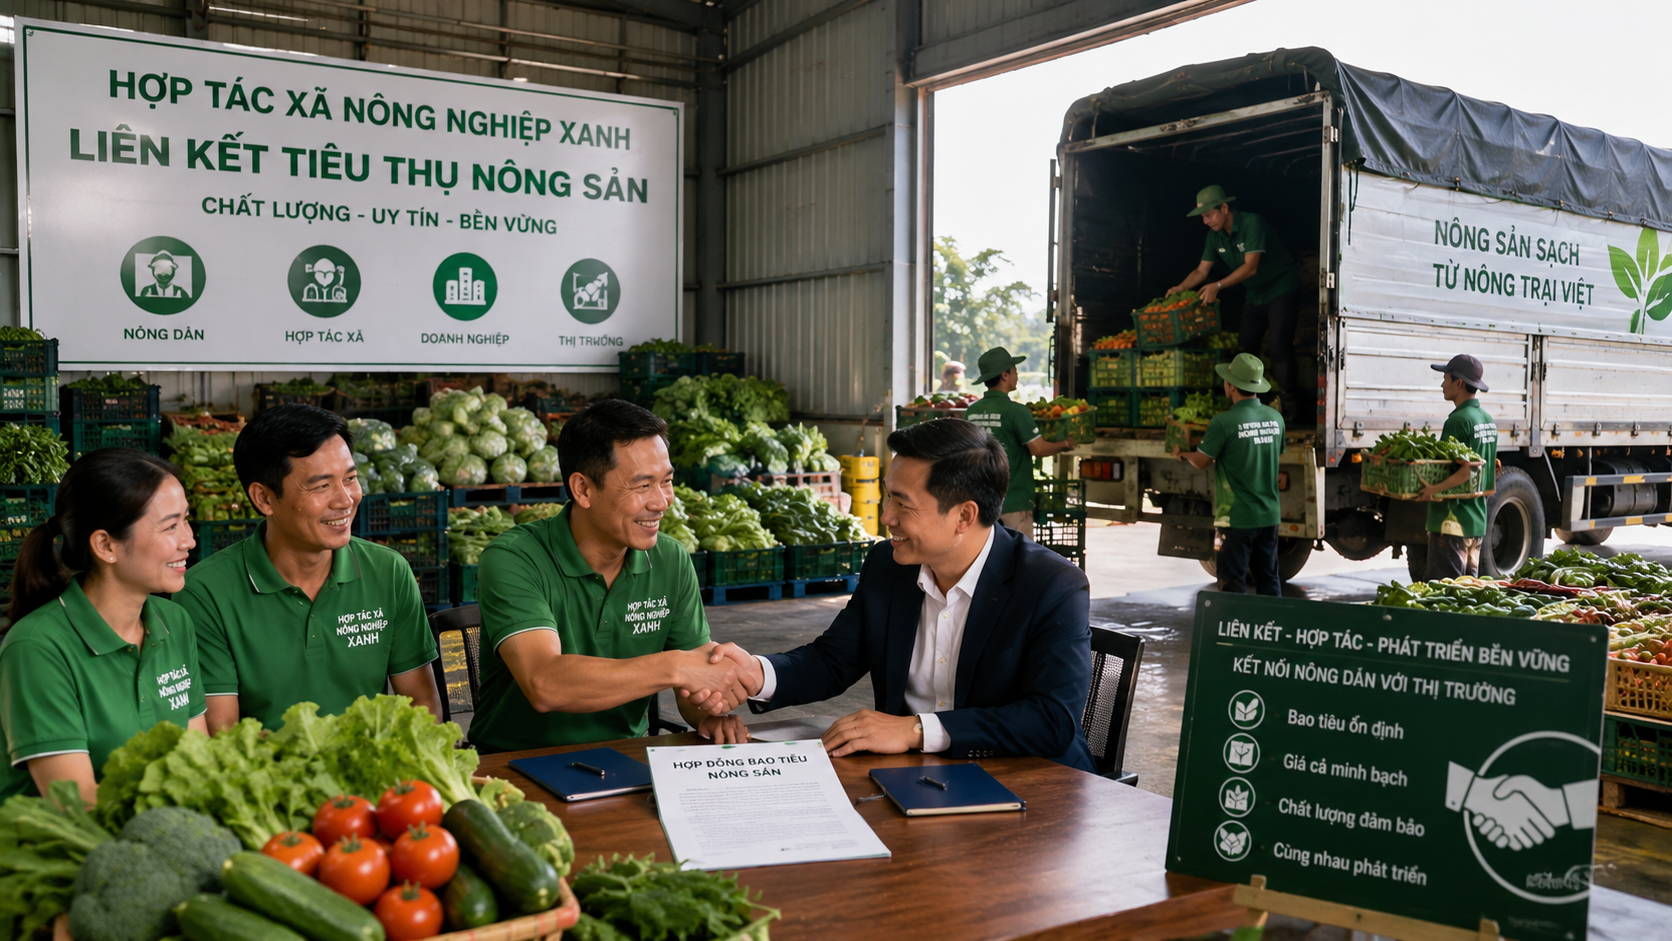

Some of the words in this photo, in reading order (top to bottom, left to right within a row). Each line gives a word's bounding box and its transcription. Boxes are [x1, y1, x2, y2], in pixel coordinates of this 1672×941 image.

[109, 69, 193, 110] HỢP
[204, 76, 275, 115] TÁC
[285, 86, 333, 121] XÃ
[343, 92, 436, 131] NÔNG
[446, 108, 552, 147] NGHIỆP
[559, 119, 631, 151] XANH
[69, 123, 170, 167] LIÊN
[187, 131, 269, 174] KẾT
[281, 142, 370, 182] TIÊU
[383, 155, 459, 196] THỤ
[472, 158, 571, 198] NÔNG
[582, 166, 648, 204] SẢN
[201, 193, 265, 217] CHẤT
[272, 200, 351, 225] LƯỢNG
[372, 207, 400, 225] UY
[406, 206, 439, 227] TÍN
[459, 208, 498, 231] BỀN
[1435, 217, 1490, 253] NÔNG
[1496, 225, 1531, 259] SẢN
[1536, 237, 1580, 268] SẠCH
[1433, 258, 1460, 290] TỪ
[1464, 263, 1515, 297] NÔNG
[1521, 275, 1557, 307] TRẠI
[1561, 277, 1595, 310] VIỆT
[285, 330, 314, 345] HỢP
[318, 329, 343, 343] TÁC
[421, 332, 464, 344] DOANH
[347, 631, 379, 648] XANH
[632, 620, 661, 635] XANH
[1217, 618, 1250, 639] LIÊN
[1253, 620, 1283, 642] KẾT
[1295, 628, 1329, 649] HỢP
[1332, 629, 1363, 651] TÁC
[1377, 635, 1421, 657] PHÁT
[1425, 638, 1474, 663] TRIỂN
[1233, 654, 1262, 675] KẾT
[1264, 657, 1291, 679] NỐI
[1294, 661, 1339, 684] NÔNG
[1412, 677, 1440, 700] THỊ
[1287, 708, 1315, 727] Bao
[1318, 713, 1346, 732] tiêu
[1371, 721, 1404, 741] định
[748, 757, 776, 766] BAO
[1283, 753, 1307, 772] Giá
[1330, 762, 1367, 781] minh
[1370, 766, 1408, 788] bạch
[1315, 803, 1356, 829] lượng
[1273, 842, 1310, 867] Cùng
[1313, 850, 1350, 871] nhau
[1353, 858, 1388, 879] phát
